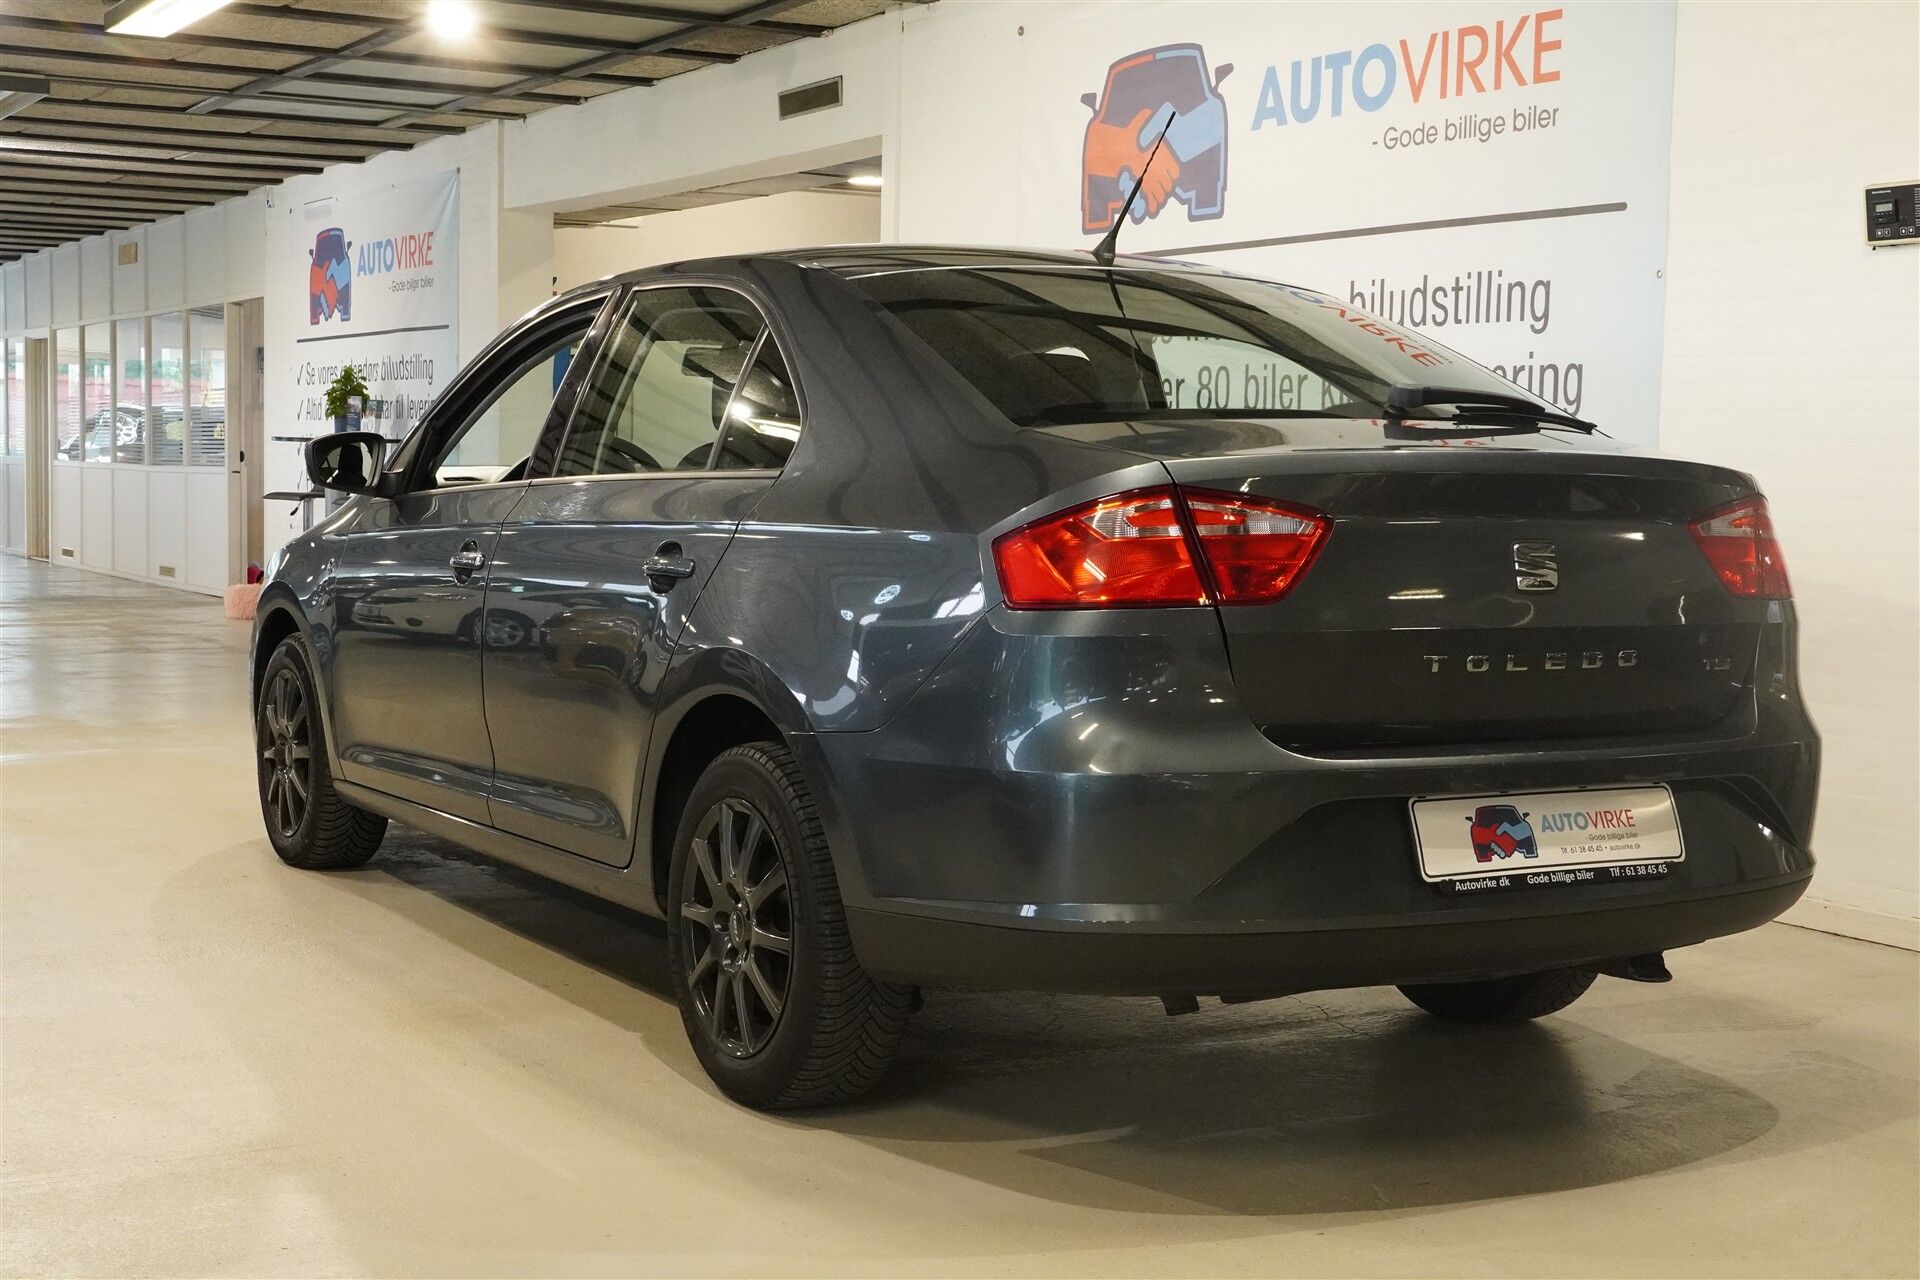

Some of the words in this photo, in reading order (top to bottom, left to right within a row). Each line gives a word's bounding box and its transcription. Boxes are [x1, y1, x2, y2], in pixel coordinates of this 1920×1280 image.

[1251, 9, 1563, 131] AUTOVIRKE
[1384, 122, 1438, 149] Gode
[1445, 113, 1506, 142] billige
[1513, 105, 1559, 132] biler
[357, 231, 434, 277] AUTOVIRKE
[306, 361, 315, 386] Se
[317, 365, 338, 384] vores
[381, 353, 434, 386] biludstilling
[1197, 365, 1230, 409] 80
[1244, 363, 1308, 409] biler
[306, 397, 322, 421] Altid
[395, 393, 404, 419] til
[1423, 650, 1638, 673] TOLEDO
[1541, 809, 1636, 833] AUTOVIRKE
[1527, 873, 1549, 884] Gode
[1550, 871, 1575, 883] billige
[1576, 870, 1594, 880] biler
[1625, 866, 1635, 876] 61
[1636, 865, 1646, 875] 38
[1647, 865, 1657, 874] 45
[1658, 864, 1668, 874] 45
